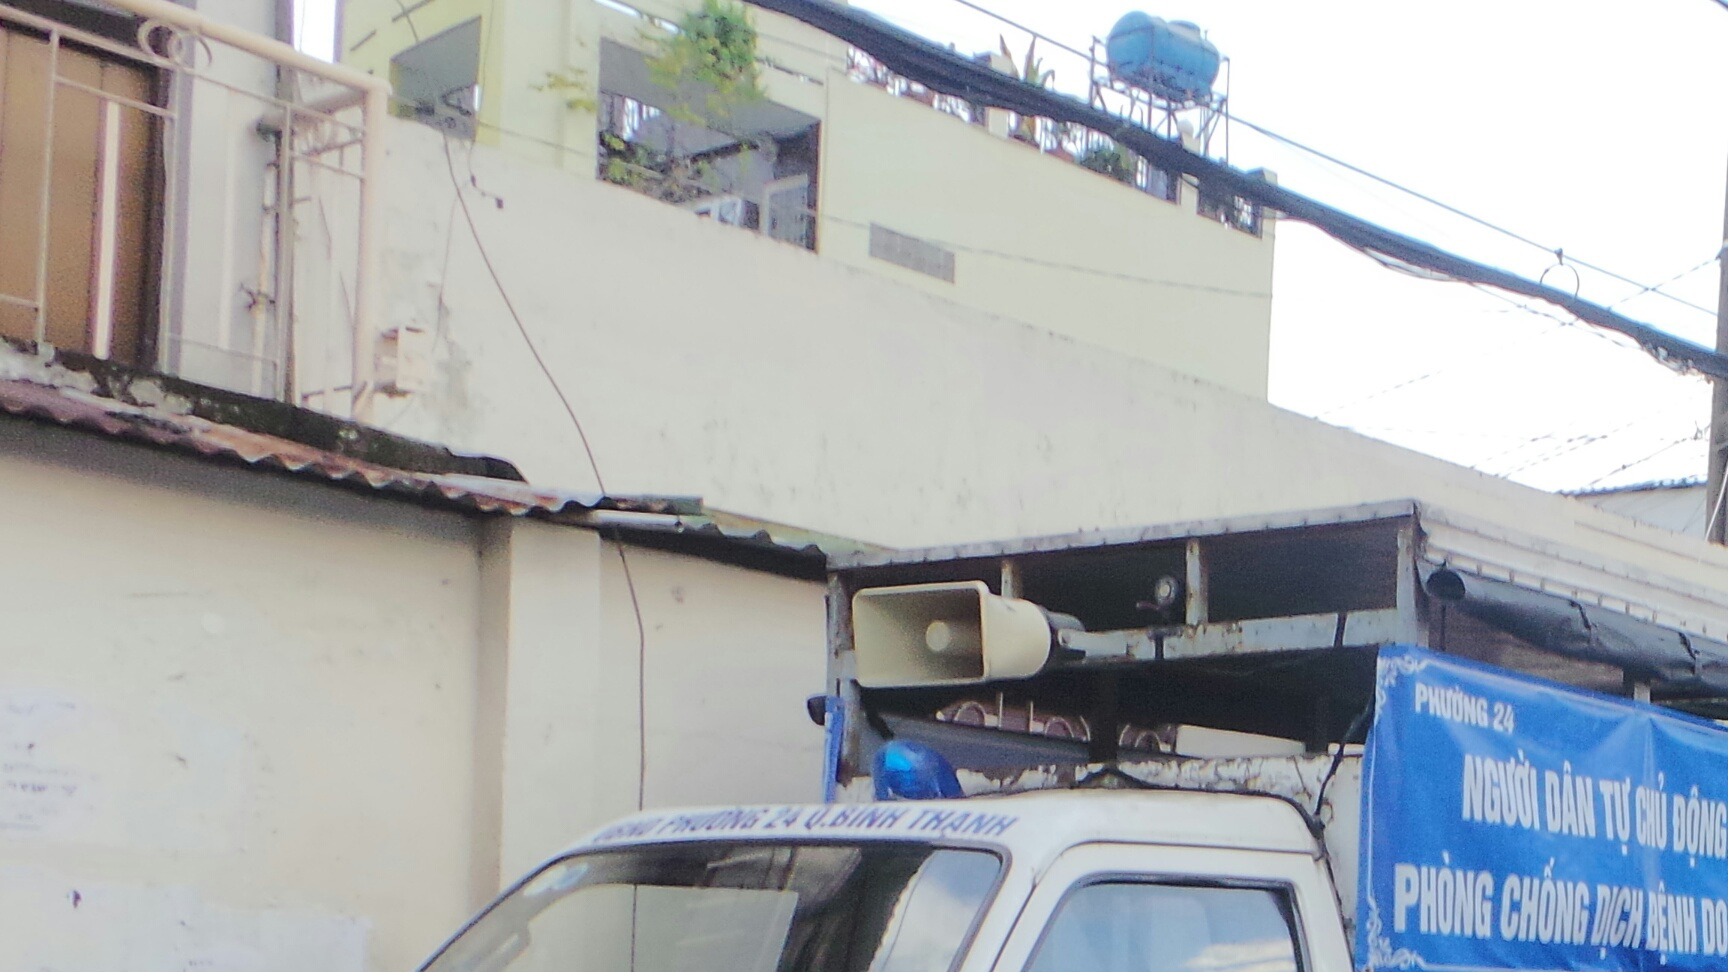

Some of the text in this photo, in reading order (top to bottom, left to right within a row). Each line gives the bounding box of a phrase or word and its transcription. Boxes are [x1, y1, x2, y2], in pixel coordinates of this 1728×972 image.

[1415, 681, 1516, 734] PHƯỜNG 24
[1462, 748, 1540, 830] NGƯỜI
[1545, 760, 1596, 838] DÂN
[1600, 777, 1631, 856] TỰ
[1635, 771, 1667, 850] CHỦ
[1673, 784, 1727, 868] ĐỘNG
[1393, 850, 1494, 939] PHÒNG
[1500, 857, 1590, 945] CHỐNG
[1590, 883, 1644, 960] DỊCH
[1645, 880, 1697, 965] BỆNH
[1701, 898, 1728, 957] DO
